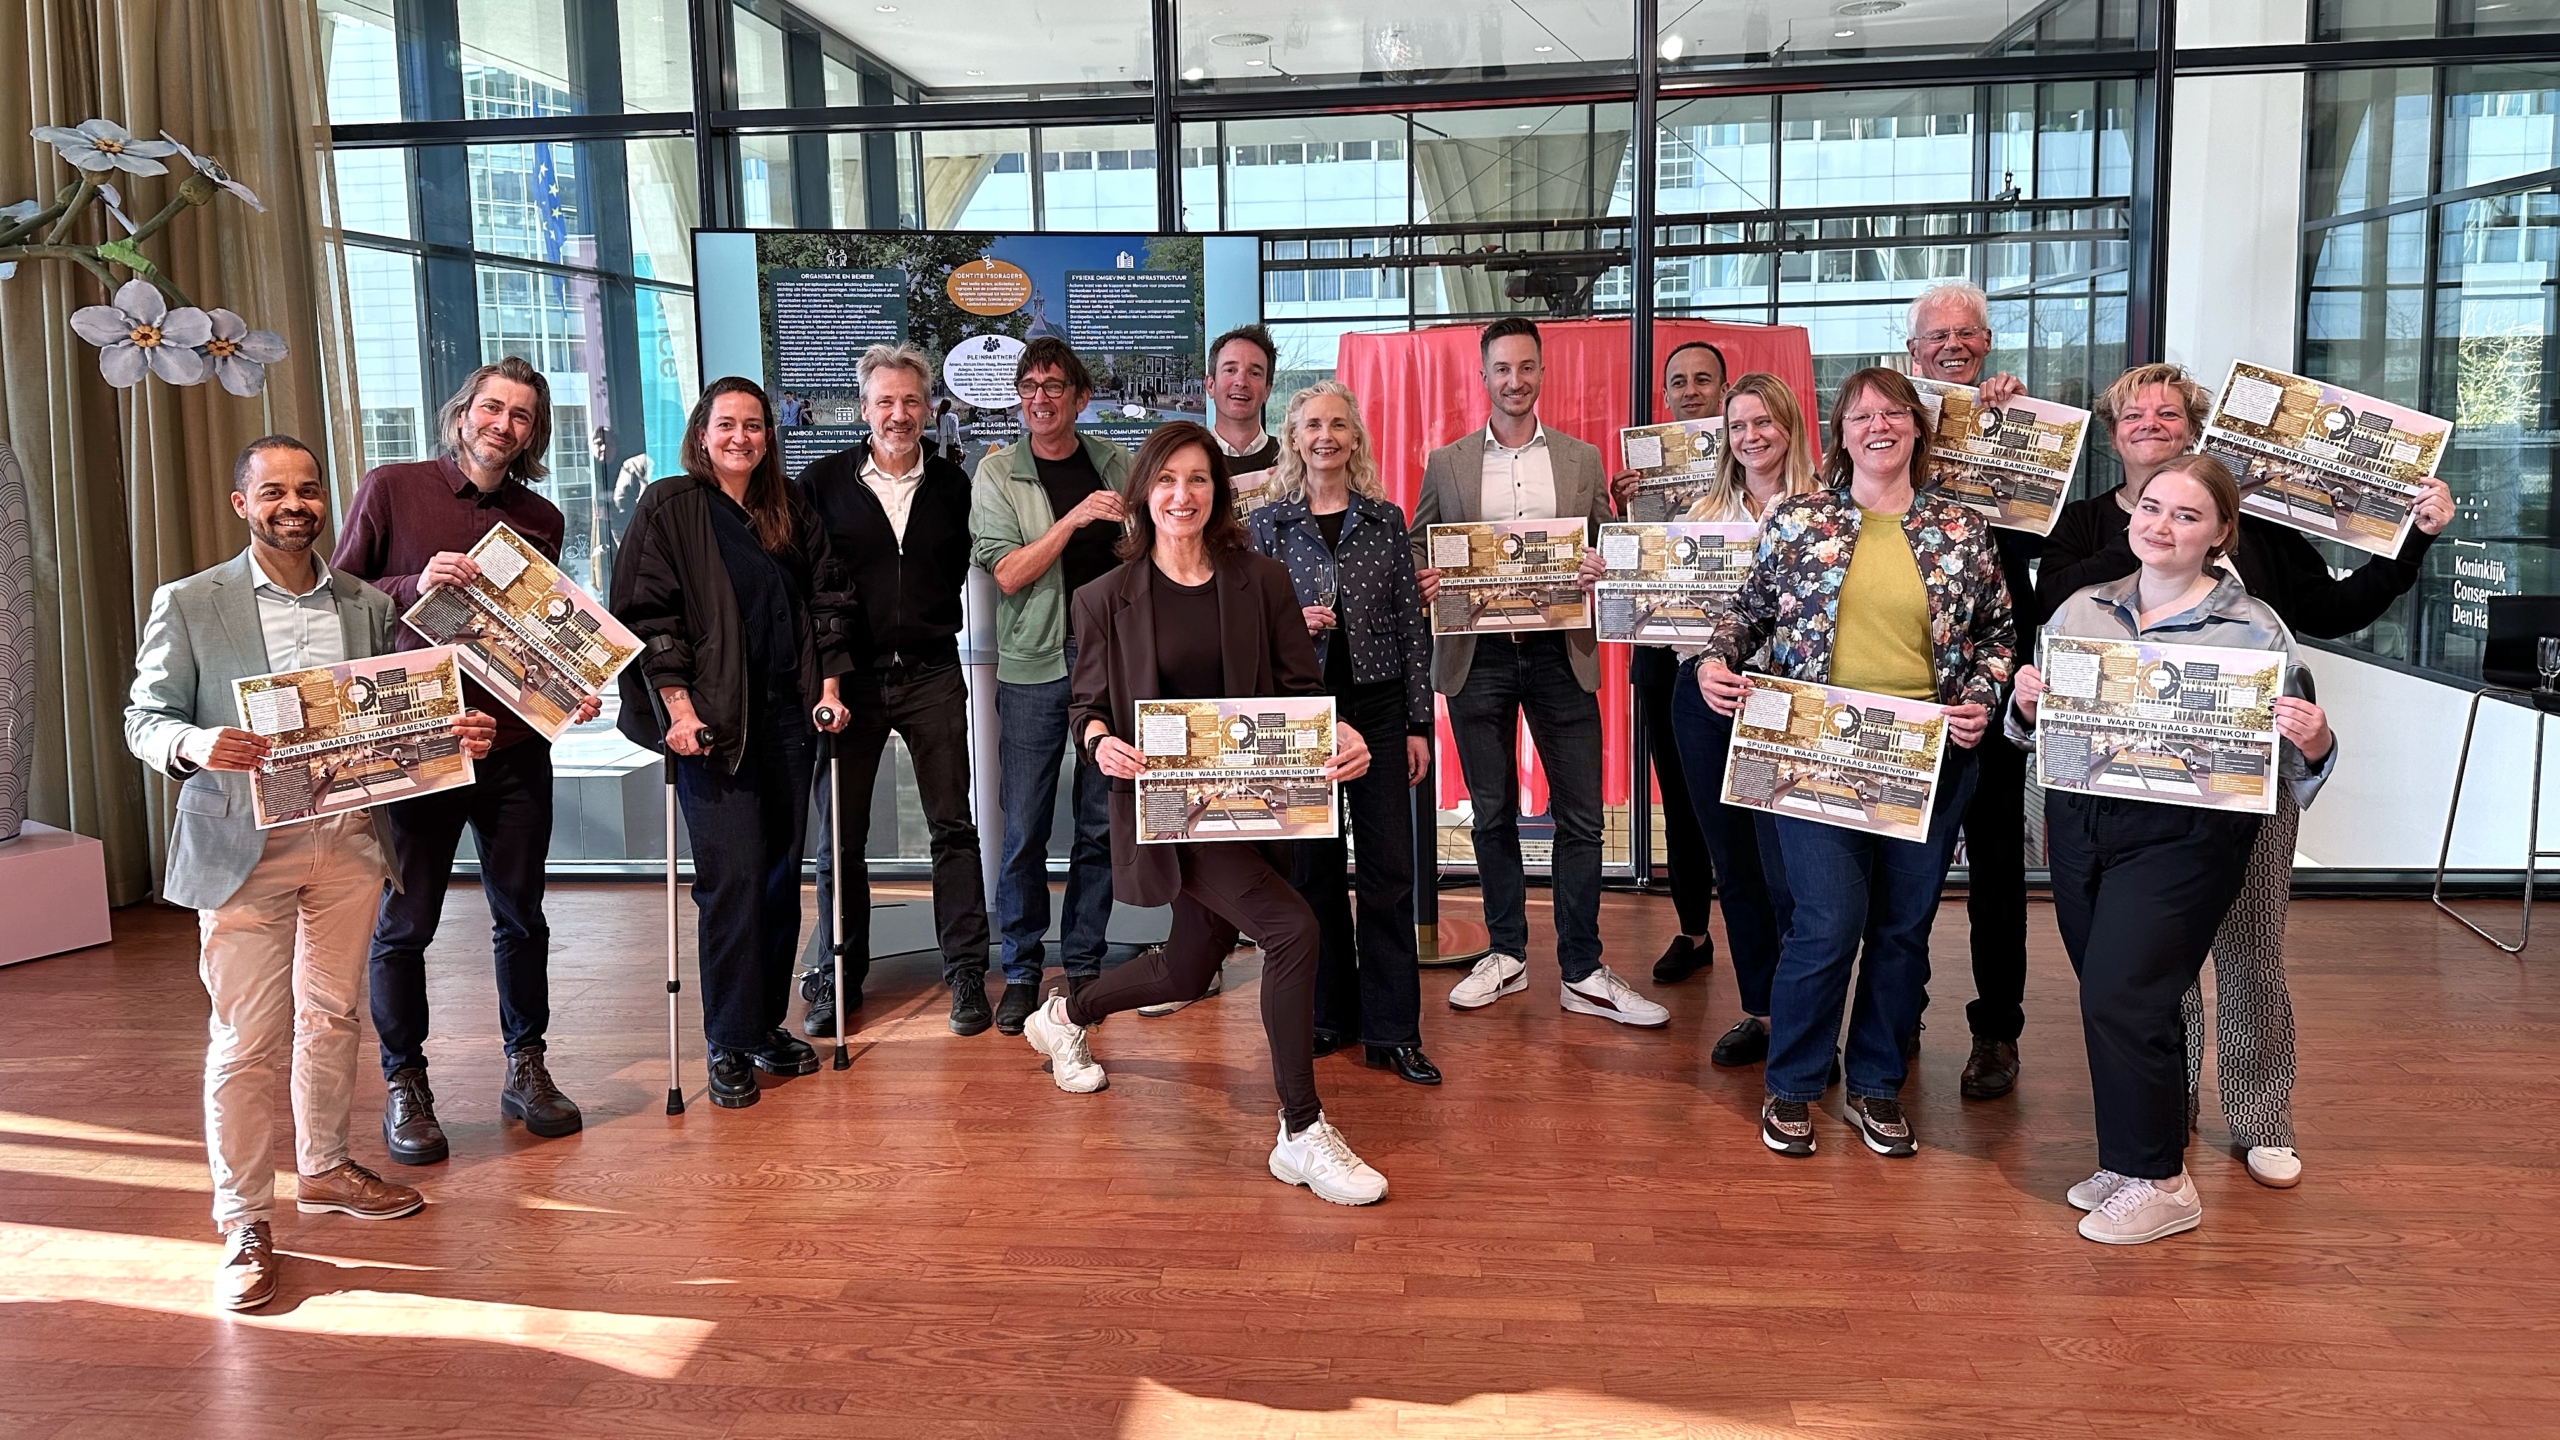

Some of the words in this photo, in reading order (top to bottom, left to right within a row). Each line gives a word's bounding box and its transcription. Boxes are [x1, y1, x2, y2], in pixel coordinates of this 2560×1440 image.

[1942, 450, 1963, 459] WAAR
[1980, 457, 2001, 466] HAAG
[2004, 462, 2054, 476] SAMENKOMT
[2272, 446, 2299, 460] WAAR
[2300, 455, 2319, 466] DEN
[2321, 460, 2347, 474] HAAG
[2349, 468, 2408, 491] SAMENKOMT
[2455, 556, 2506, 585] Koninklijk
[2453, 604, 2472, 626] Den
[2474, 608, 2488, 629] Ha
[496, 610, 516, 628] WAAR
[516, 626, 531, 639] DEN
[530, 636, 550, 654] HAAG
[549, 652, 588, 687] SAMENKOMT
[320, 738, 346, 748] WAAR
[348, 734, 366, 742] DEN
[368, 729, 394, 740] HAAG
[396, 718, 449, 734] SAMENKOMT
[2107, 718, 2135, 728] WAAR
[2138, 722, 2158, 730] DEN
[2160, 724, 2188, 733] HAAG
[2192, 726, 2256, 740] SAMENKOMT
[1269, 768, 1320, 776] SAMENKOMT
[1794, 750, 1818, 759] WAAR
[1821, 754, 1838, 762] DEN
[1840, 758, 1864, 767] HAAG
[1866, 762, 1920, 778] SAMENKOMT
